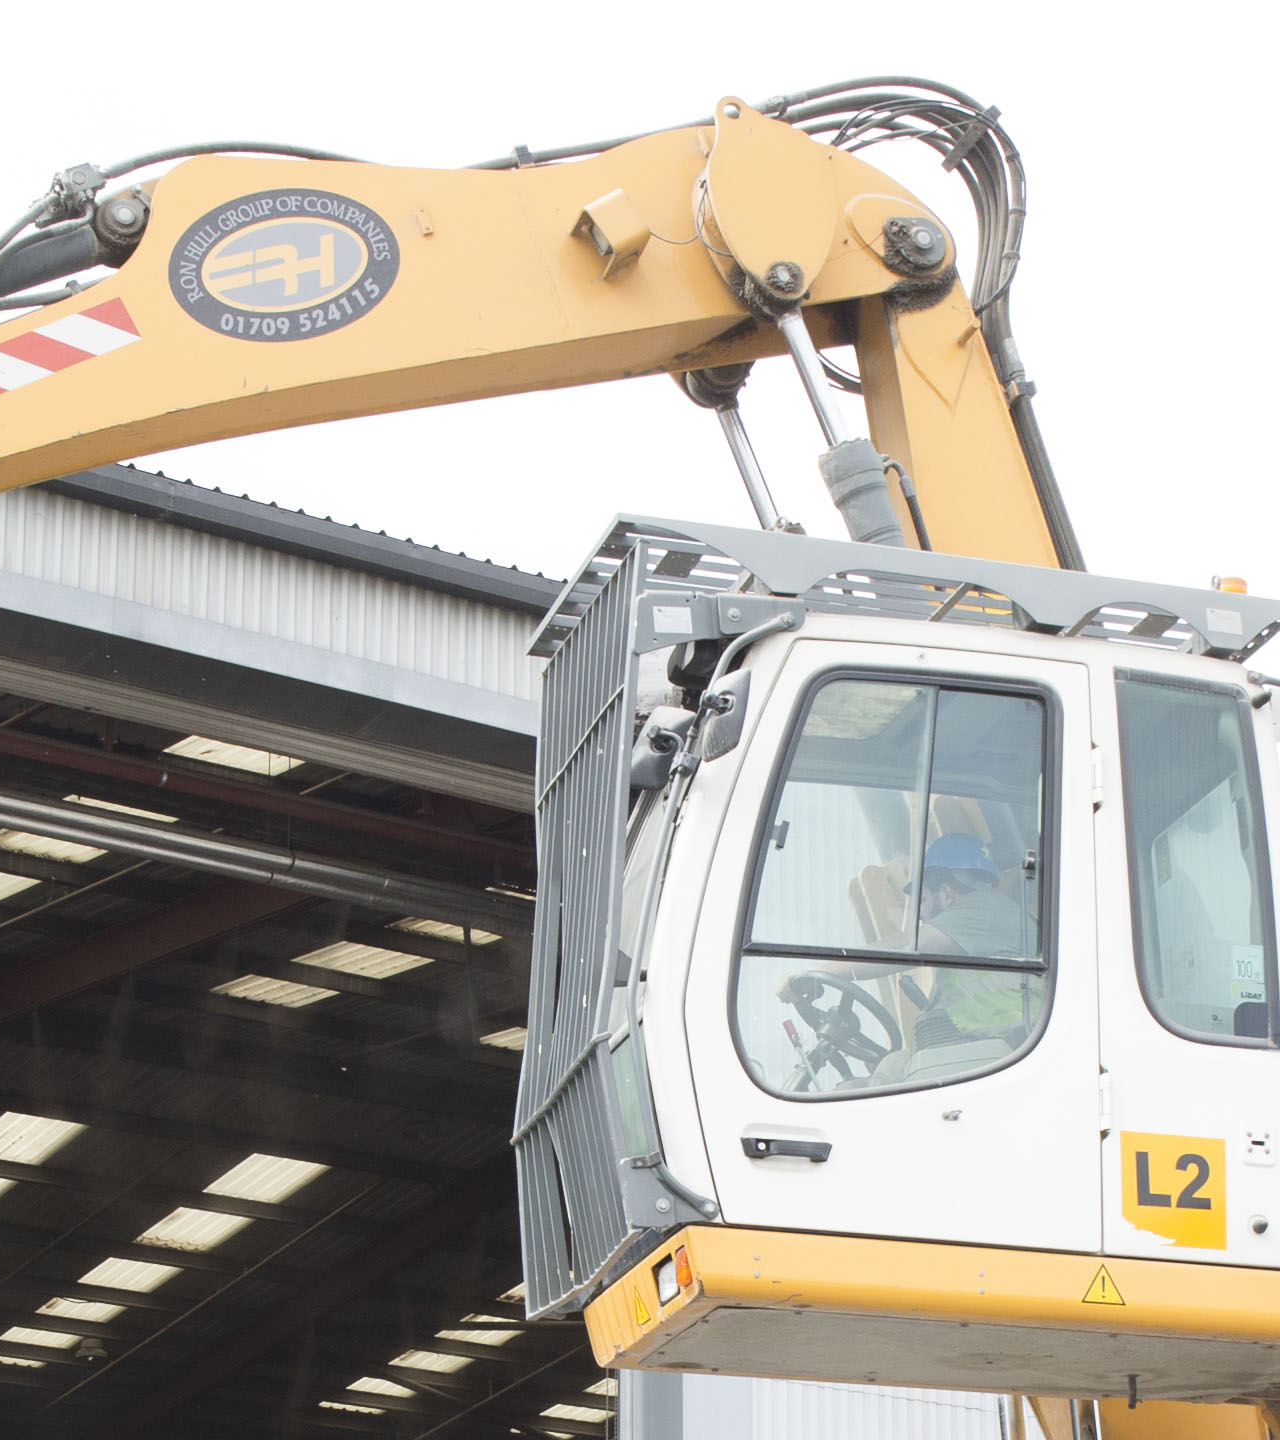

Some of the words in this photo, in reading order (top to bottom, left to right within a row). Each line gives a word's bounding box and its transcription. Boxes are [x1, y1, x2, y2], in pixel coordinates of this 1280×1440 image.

[218, 198, 273, 232] GROUP
[276, 195, 302, 212] OF
[184, 227, 221, 262] HULL
[303, 196, 391, 261] COMPANIES
[179, 261, 205, 304] RON
[220, 313, 290, 336] 01709
[299, 278, 380, 333] 524115
[1135, 1150, 1212, 1210] L2
